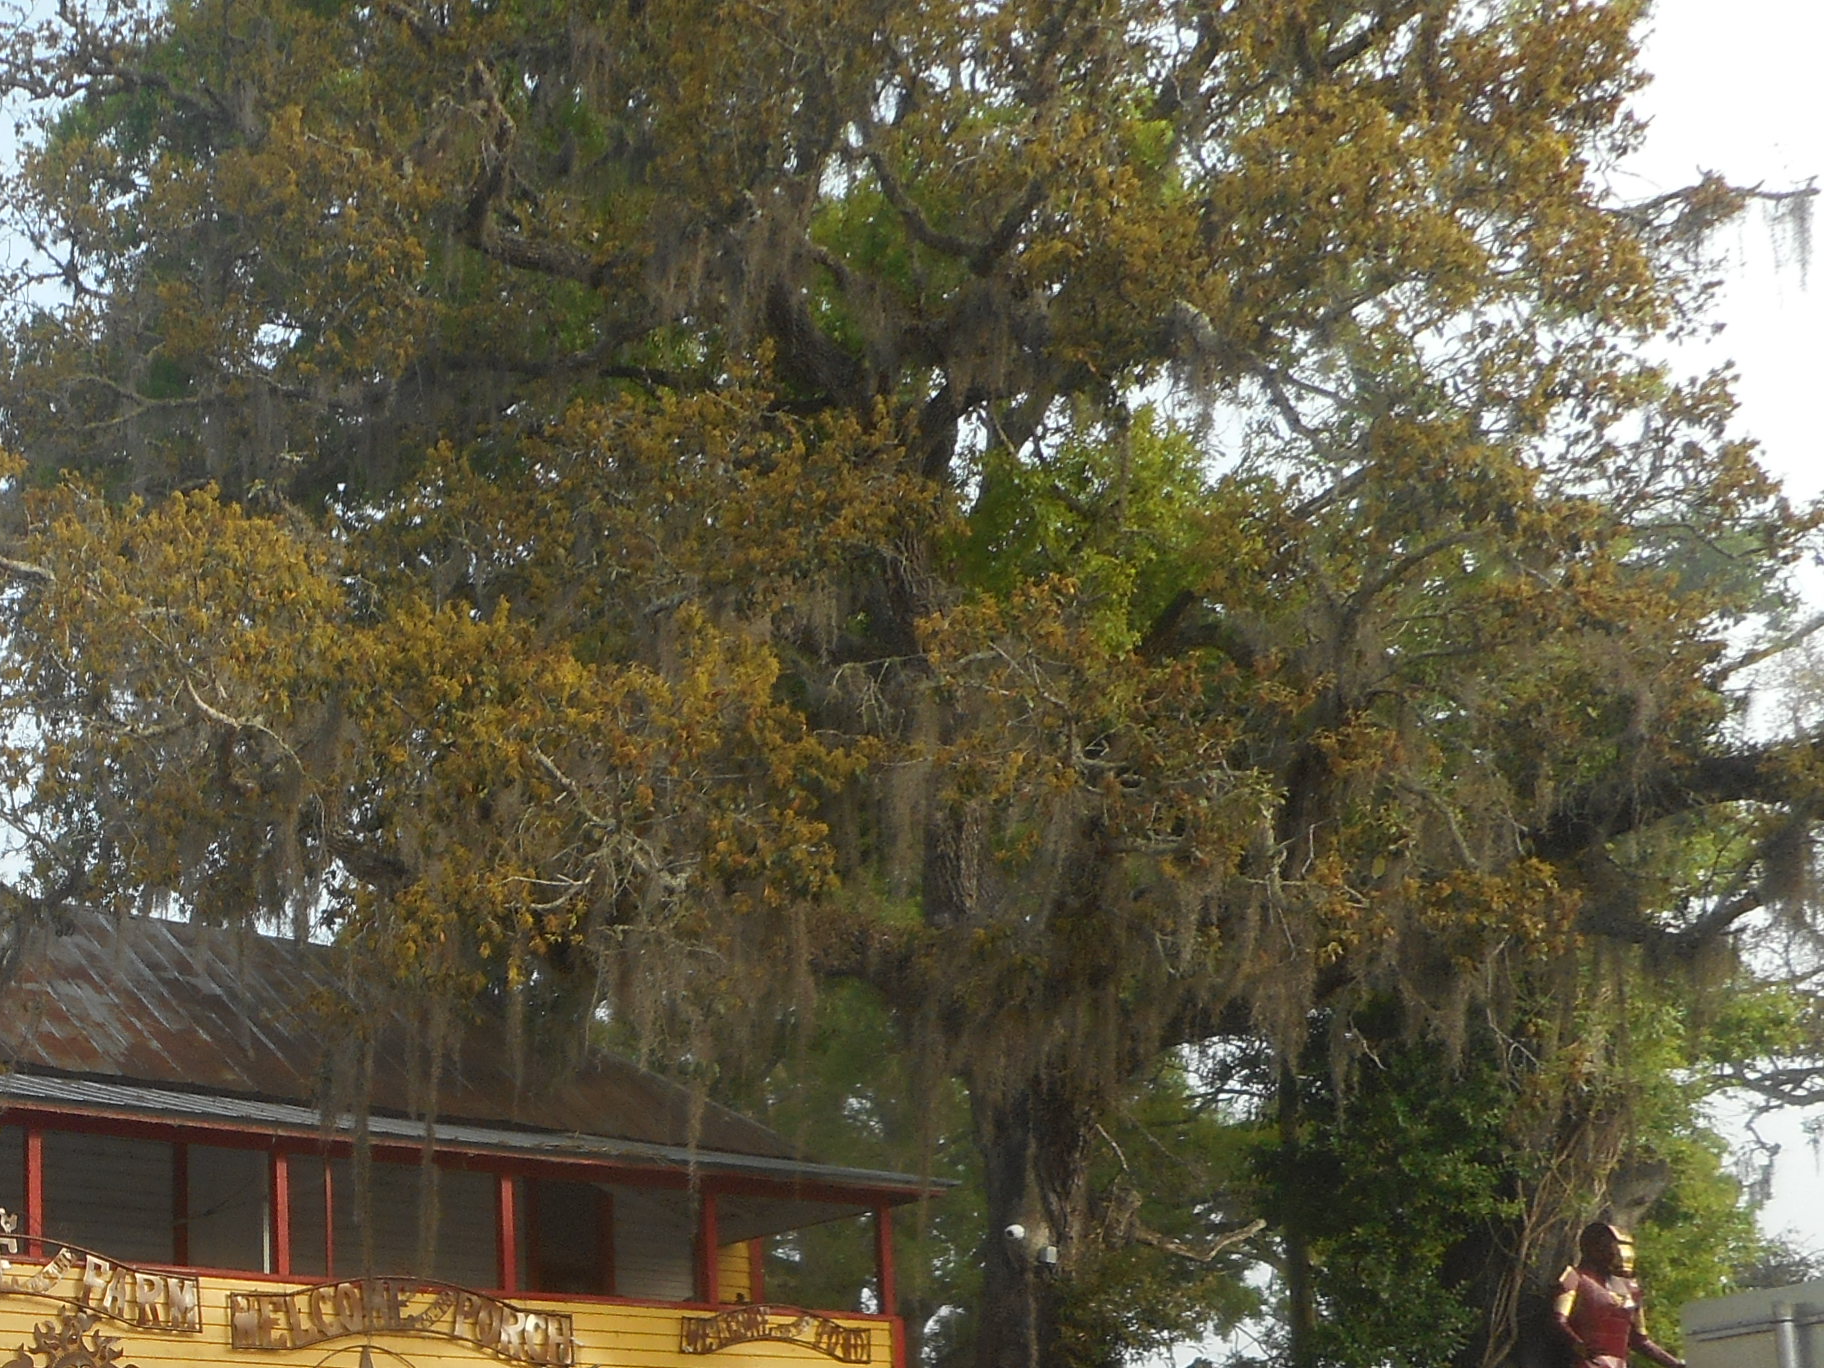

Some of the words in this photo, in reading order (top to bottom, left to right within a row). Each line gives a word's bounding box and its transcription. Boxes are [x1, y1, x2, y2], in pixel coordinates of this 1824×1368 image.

[83, 1253, 198, 1331] FARM
[233, 1279, 416, 1347] WELCOME
[454, 1292, 573, 1365] PORCH
